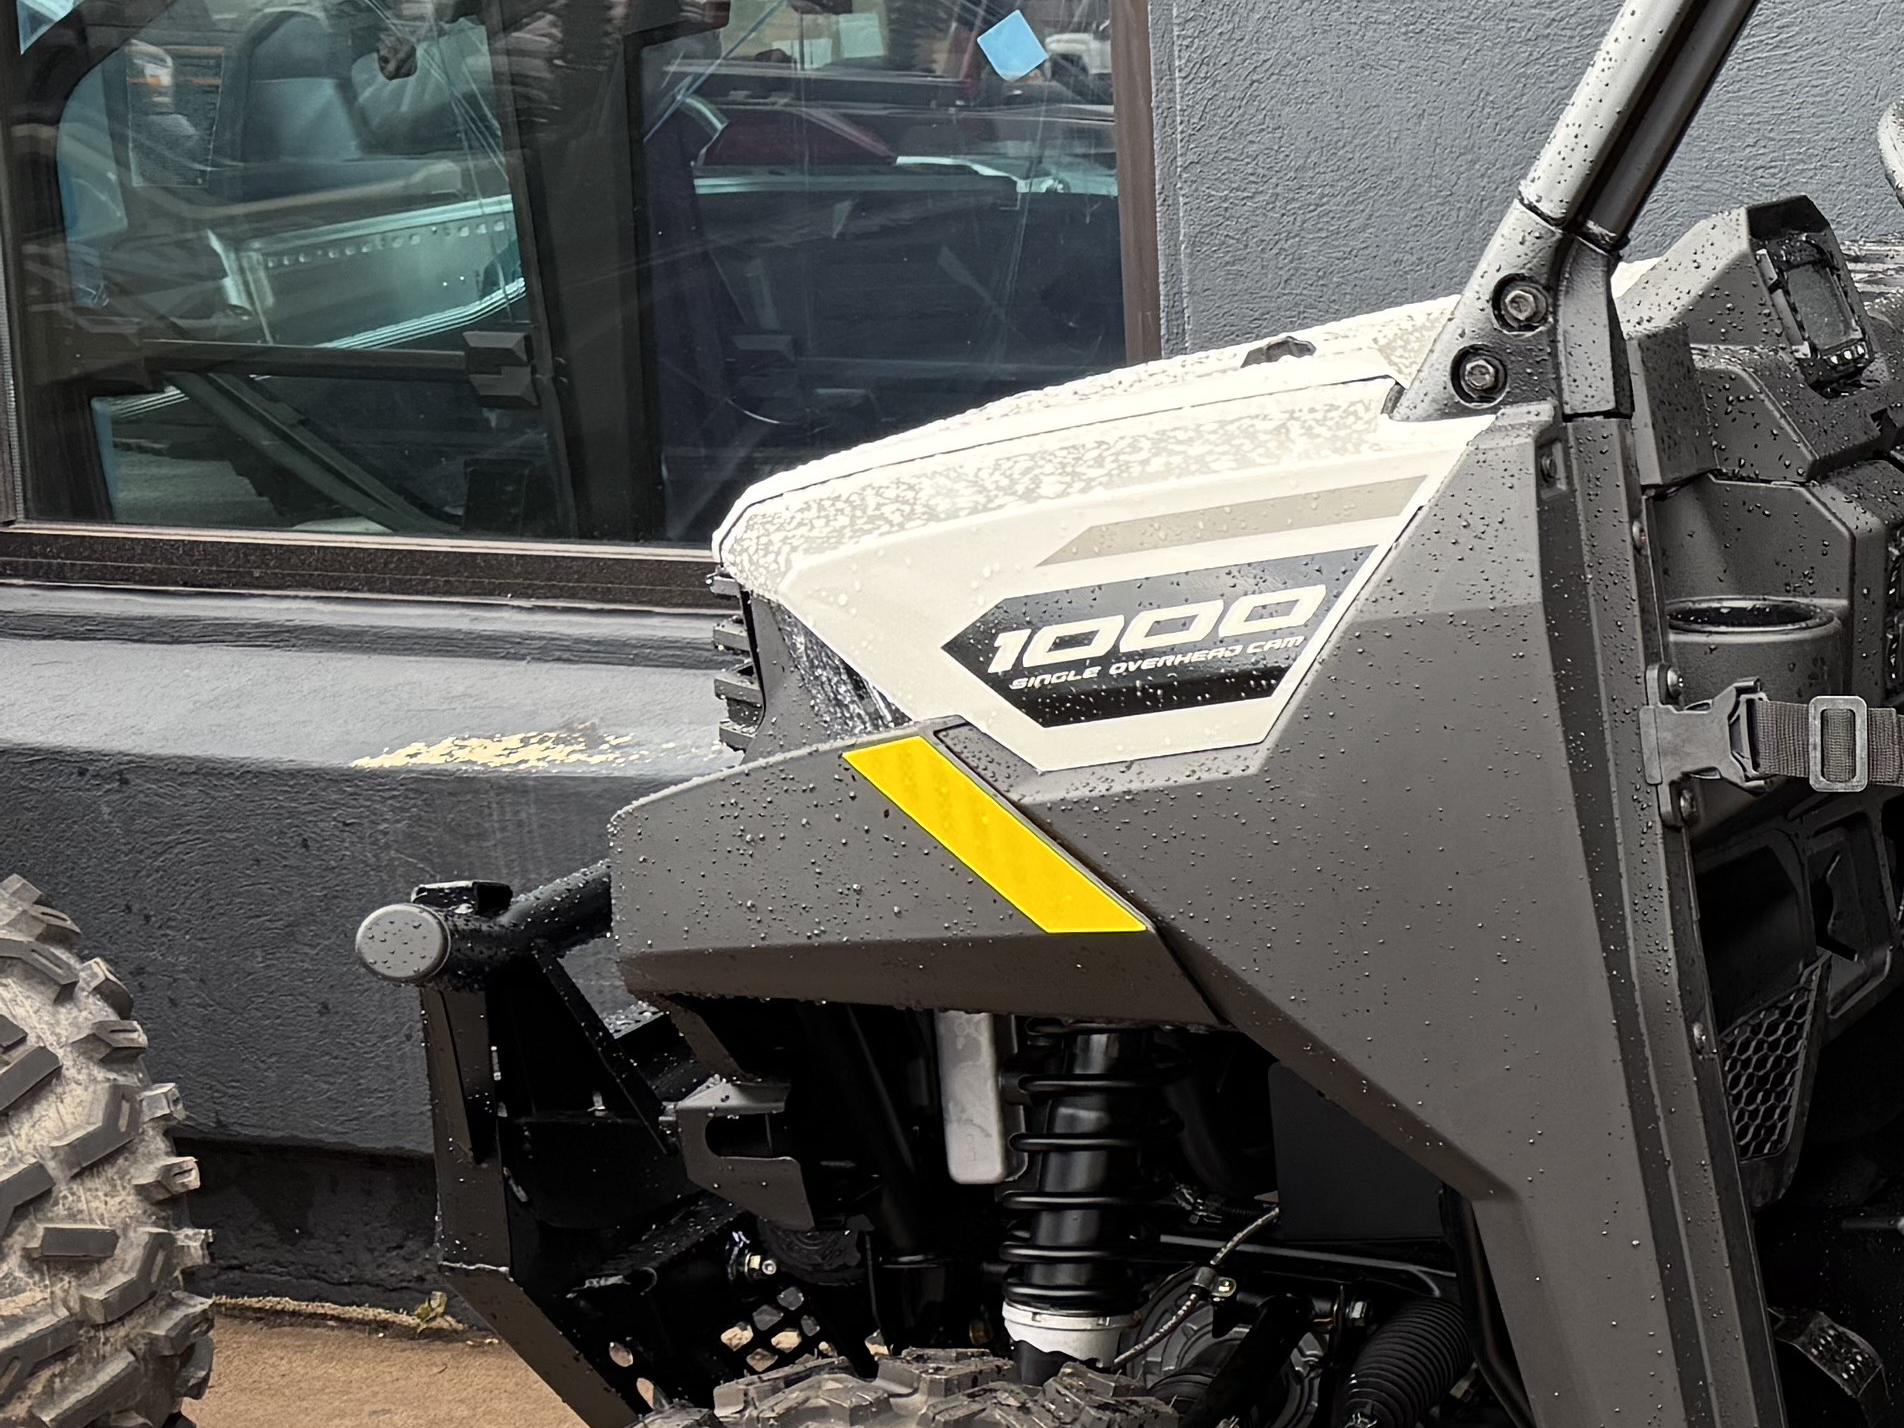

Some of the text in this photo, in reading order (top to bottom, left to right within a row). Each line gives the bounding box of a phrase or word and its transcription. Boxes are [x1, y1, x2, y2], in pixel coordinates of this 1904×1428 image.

[987, 584, 1327, 674] 1000
[1008, 635, 1306, 691] SINGLE OVERHEAD CAM
